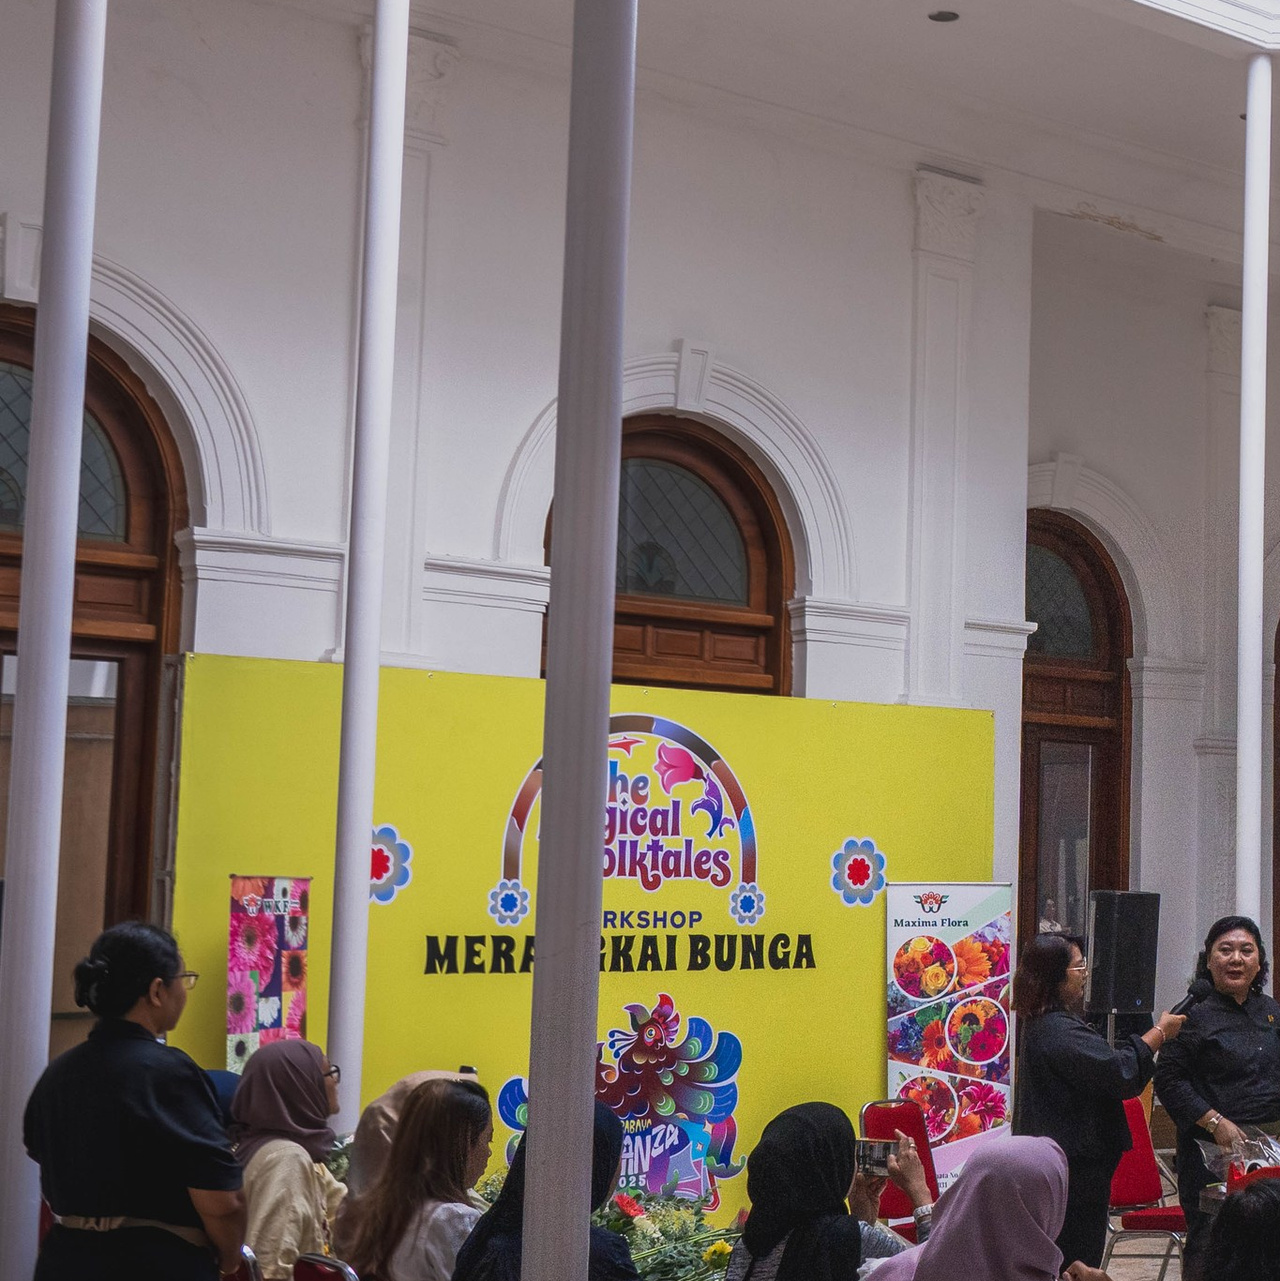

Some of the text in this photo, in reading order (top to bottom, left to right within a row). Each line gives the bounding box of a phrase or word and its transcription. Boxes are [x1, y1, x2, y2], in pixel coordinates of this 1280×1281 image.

[606, 760, 650, 806] he
[604, 800, 682, 846] gical
[603, 838, 733, 892] olktales
[602, 910, 703, 929] RKSHOP
[893, 918, 969, 928] Maxima Flora
[423, 933, 817, 975] MERAKAI BUNGA
[620, 1118, 653, 1134] ABAYA
[620, 1124, 680, 1176] ANZA
[618, 1174, 647, 1188] 025
